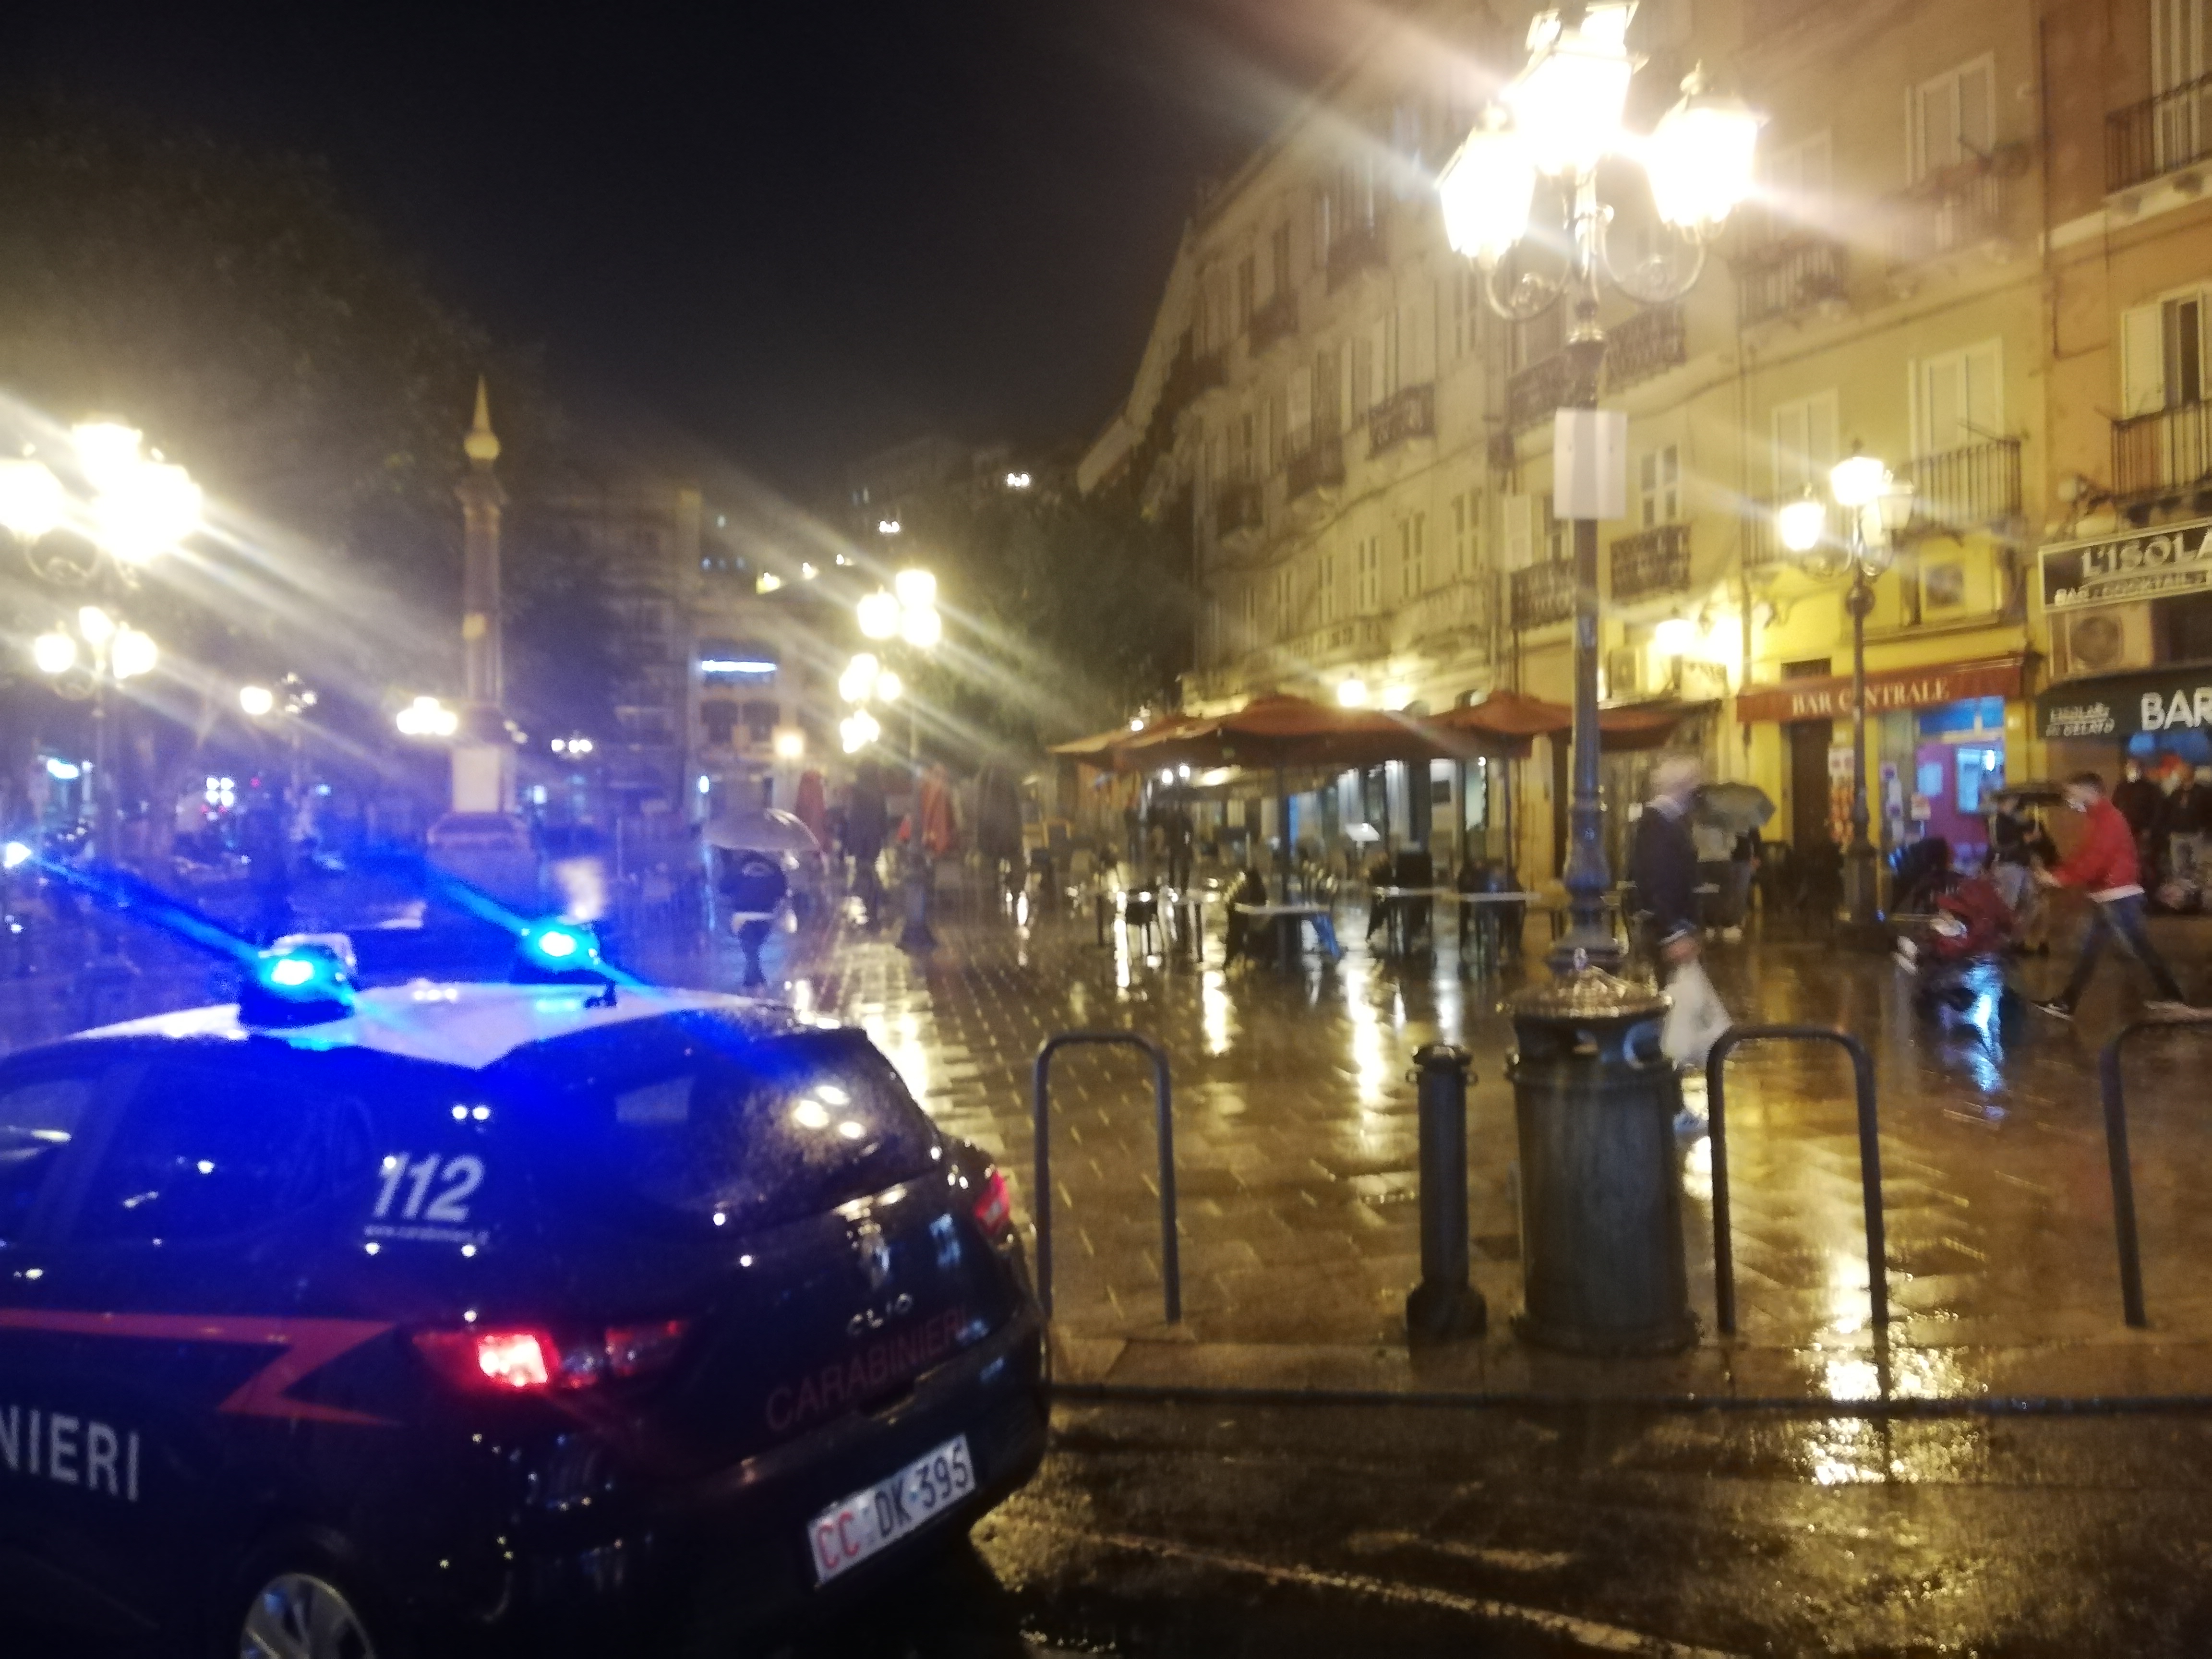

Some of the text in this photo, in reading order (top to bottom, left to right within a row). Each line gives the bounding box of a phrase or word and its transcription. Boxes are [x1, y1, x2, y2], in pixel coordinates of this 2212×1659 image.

[1792, 677, 1949, 716] BAR CNTRALE
[2141, 686, 2212, 731] BAR
[372, 1151, 484, 1222] 112
[818, 1441, 968, 1569] CC DK 395
